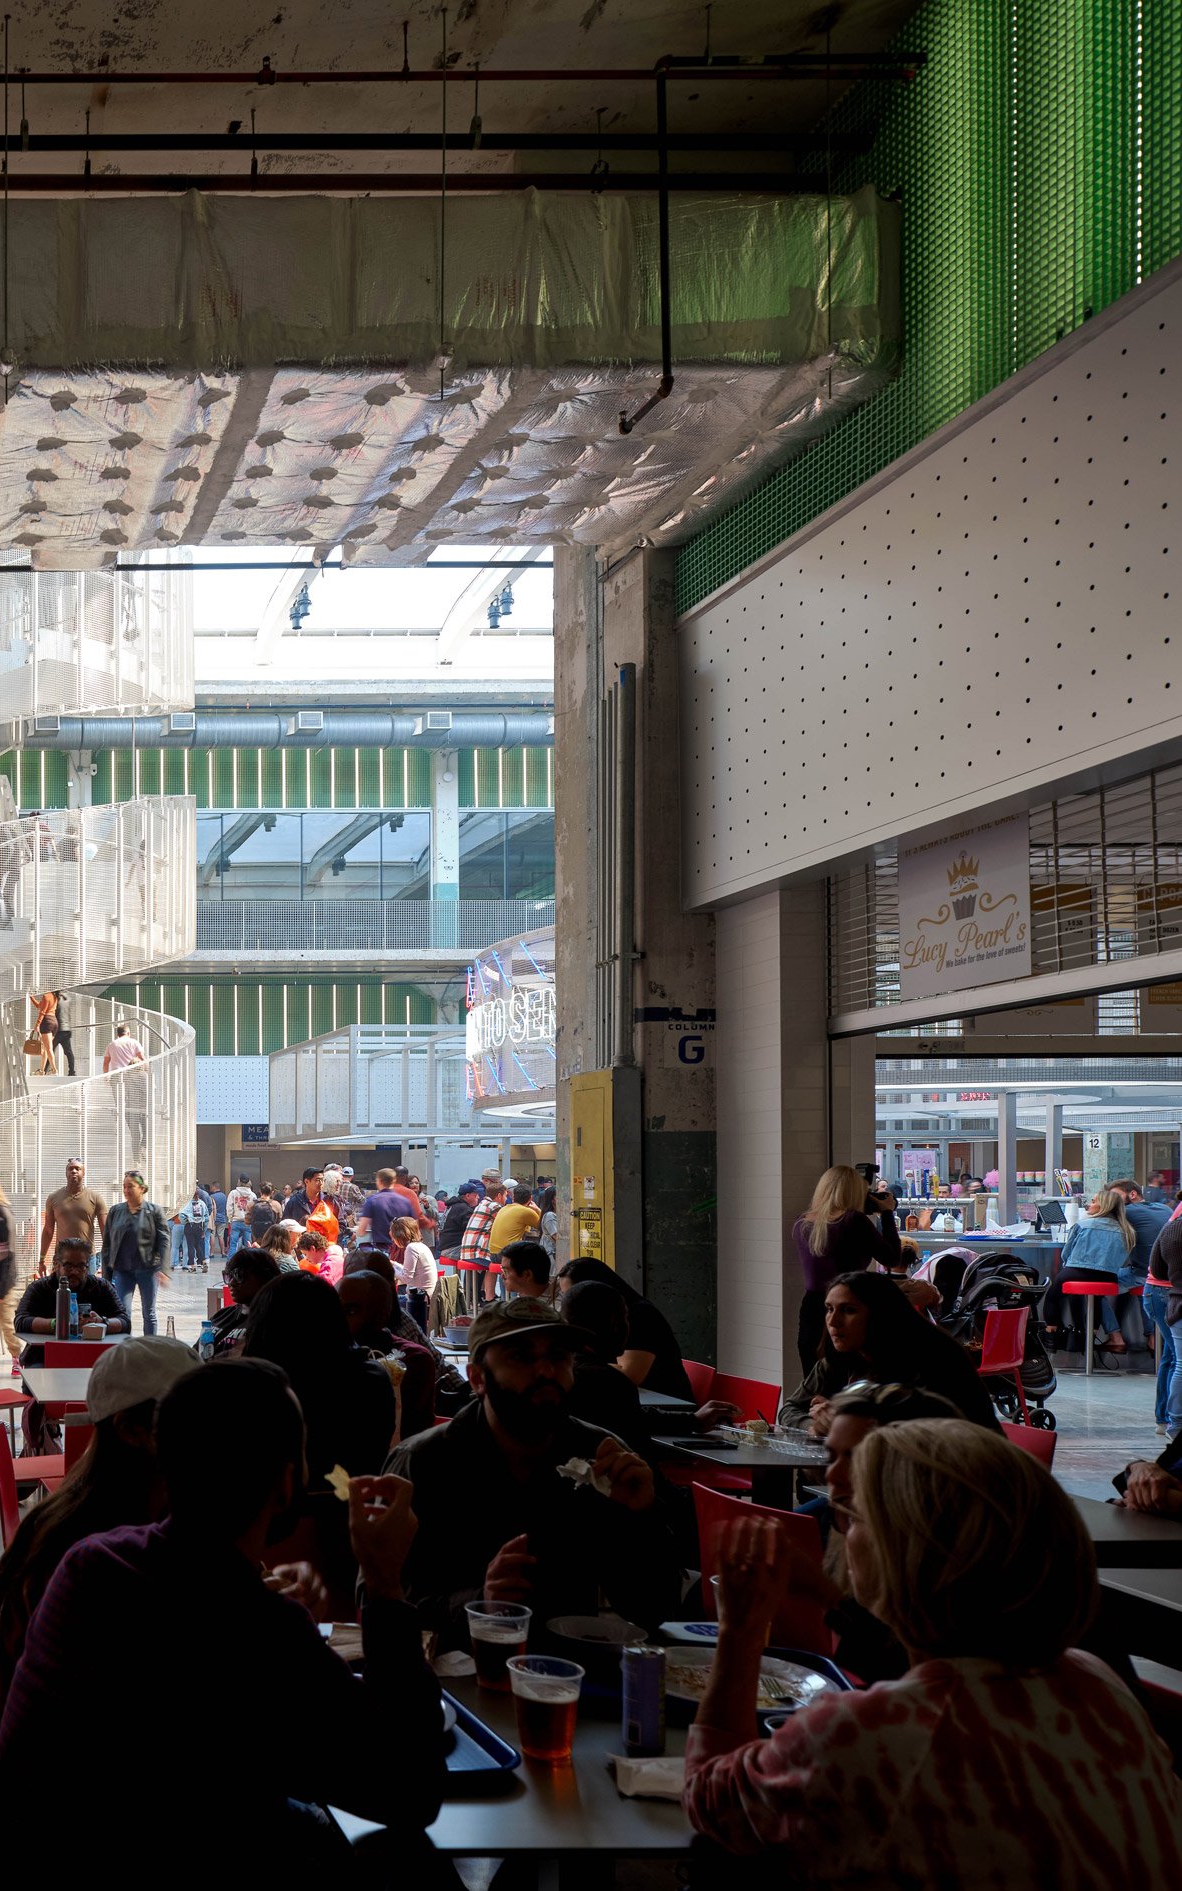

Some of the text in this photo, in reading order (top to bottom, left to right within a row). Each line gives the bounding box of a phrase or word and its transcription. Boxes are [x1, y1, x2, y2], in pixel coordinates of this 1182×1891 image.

[903, 911, 1027, 973] Lucy Pearl's
[946, 943, 1027, 968] We bake for the love of sweets!
[668, 1023, 715, 1031] COLUMN
[678, 1035, 705, 1065] G
[1089, 1138, 1099, 1148] 12
[580, 1211, 600, 1220] CAUTION
